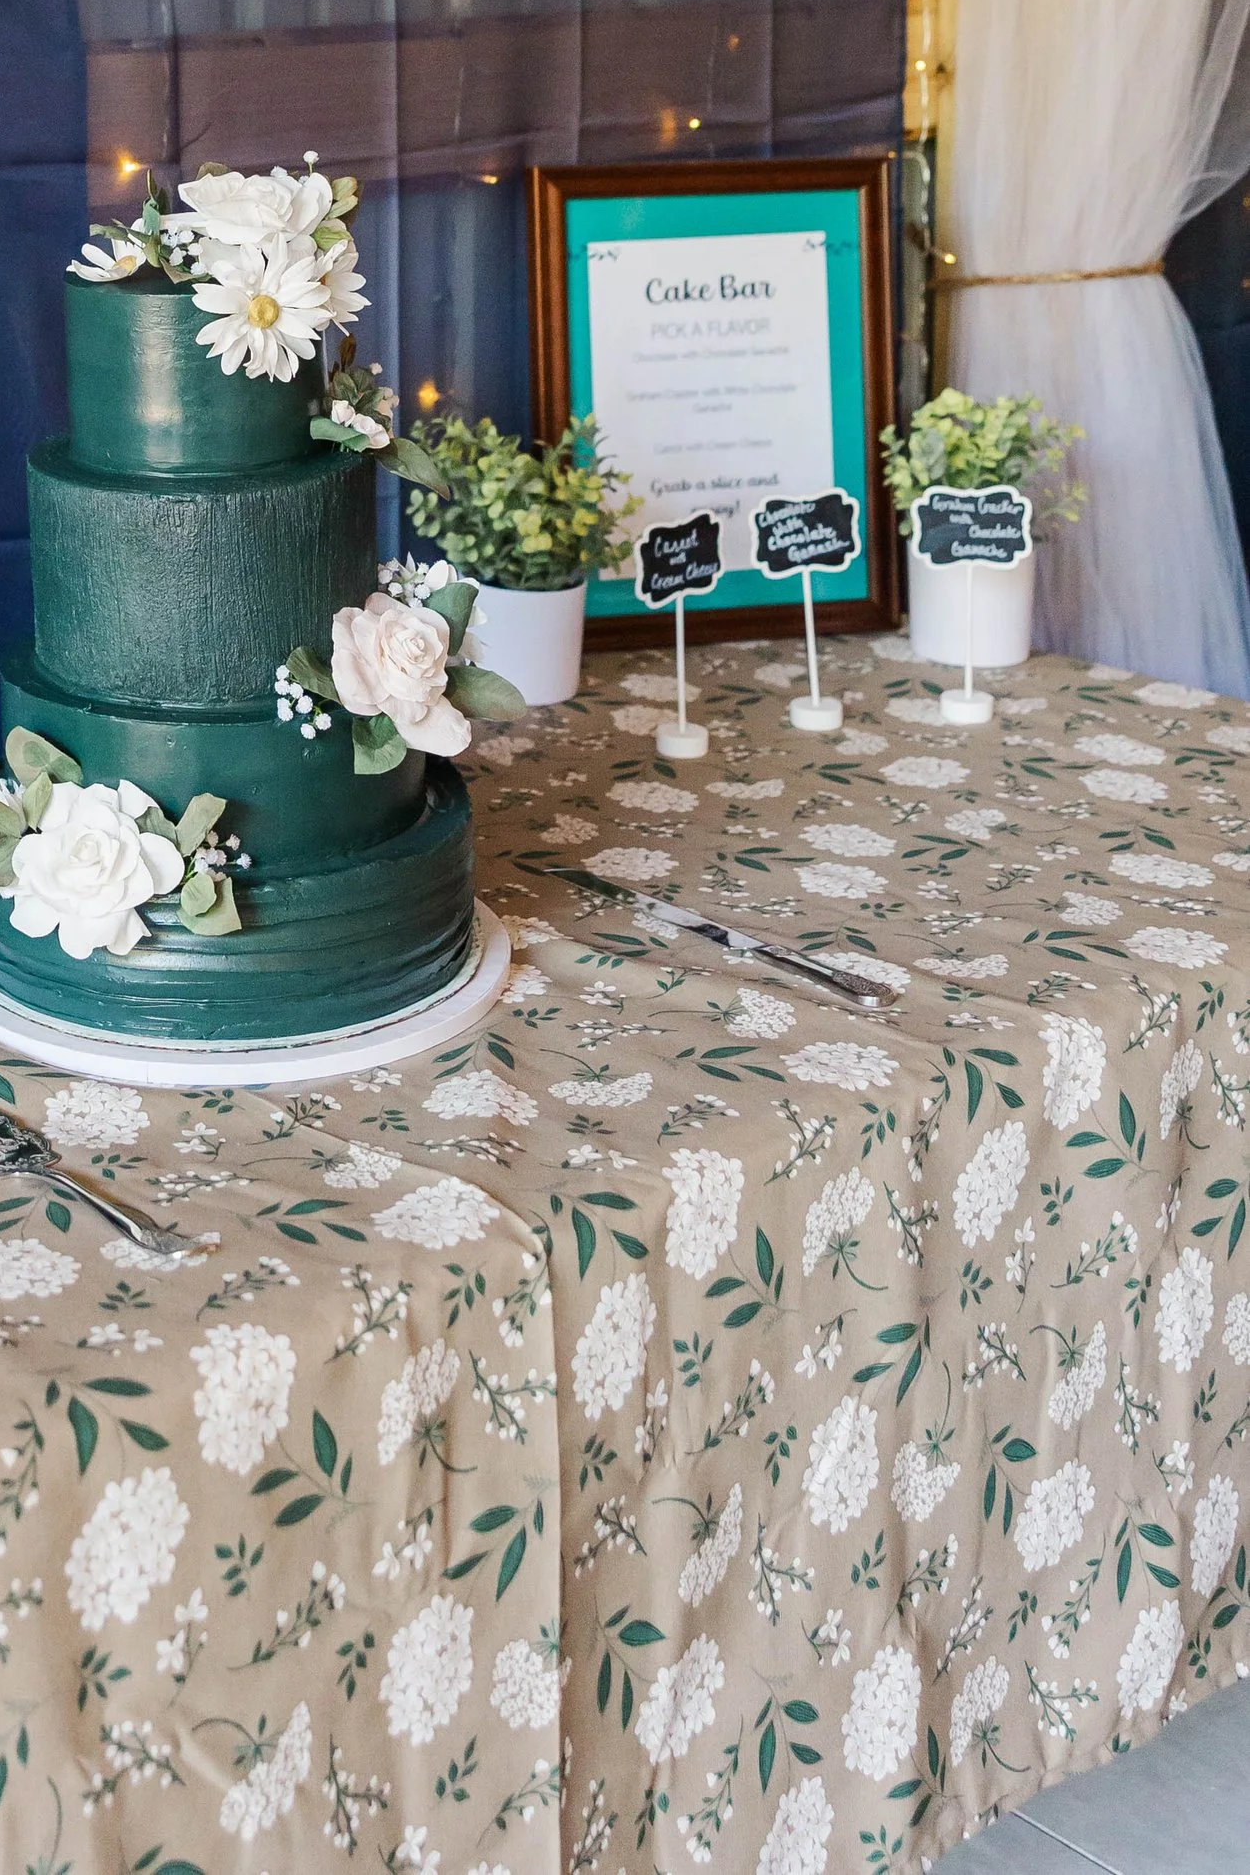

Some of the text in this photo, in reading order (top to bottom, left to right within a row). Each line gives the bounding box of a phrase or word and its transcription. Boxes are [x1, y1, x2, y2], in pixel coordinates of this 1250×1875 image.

[645, 273, 776, 305] Cake Bar
[651, 322, 686, 339] PICK
[692, 322, 702, 336] A
[650, 477, 692, 496] Grab
[695, 480, 706, 489] a
[747, 473, 779, 487] and
